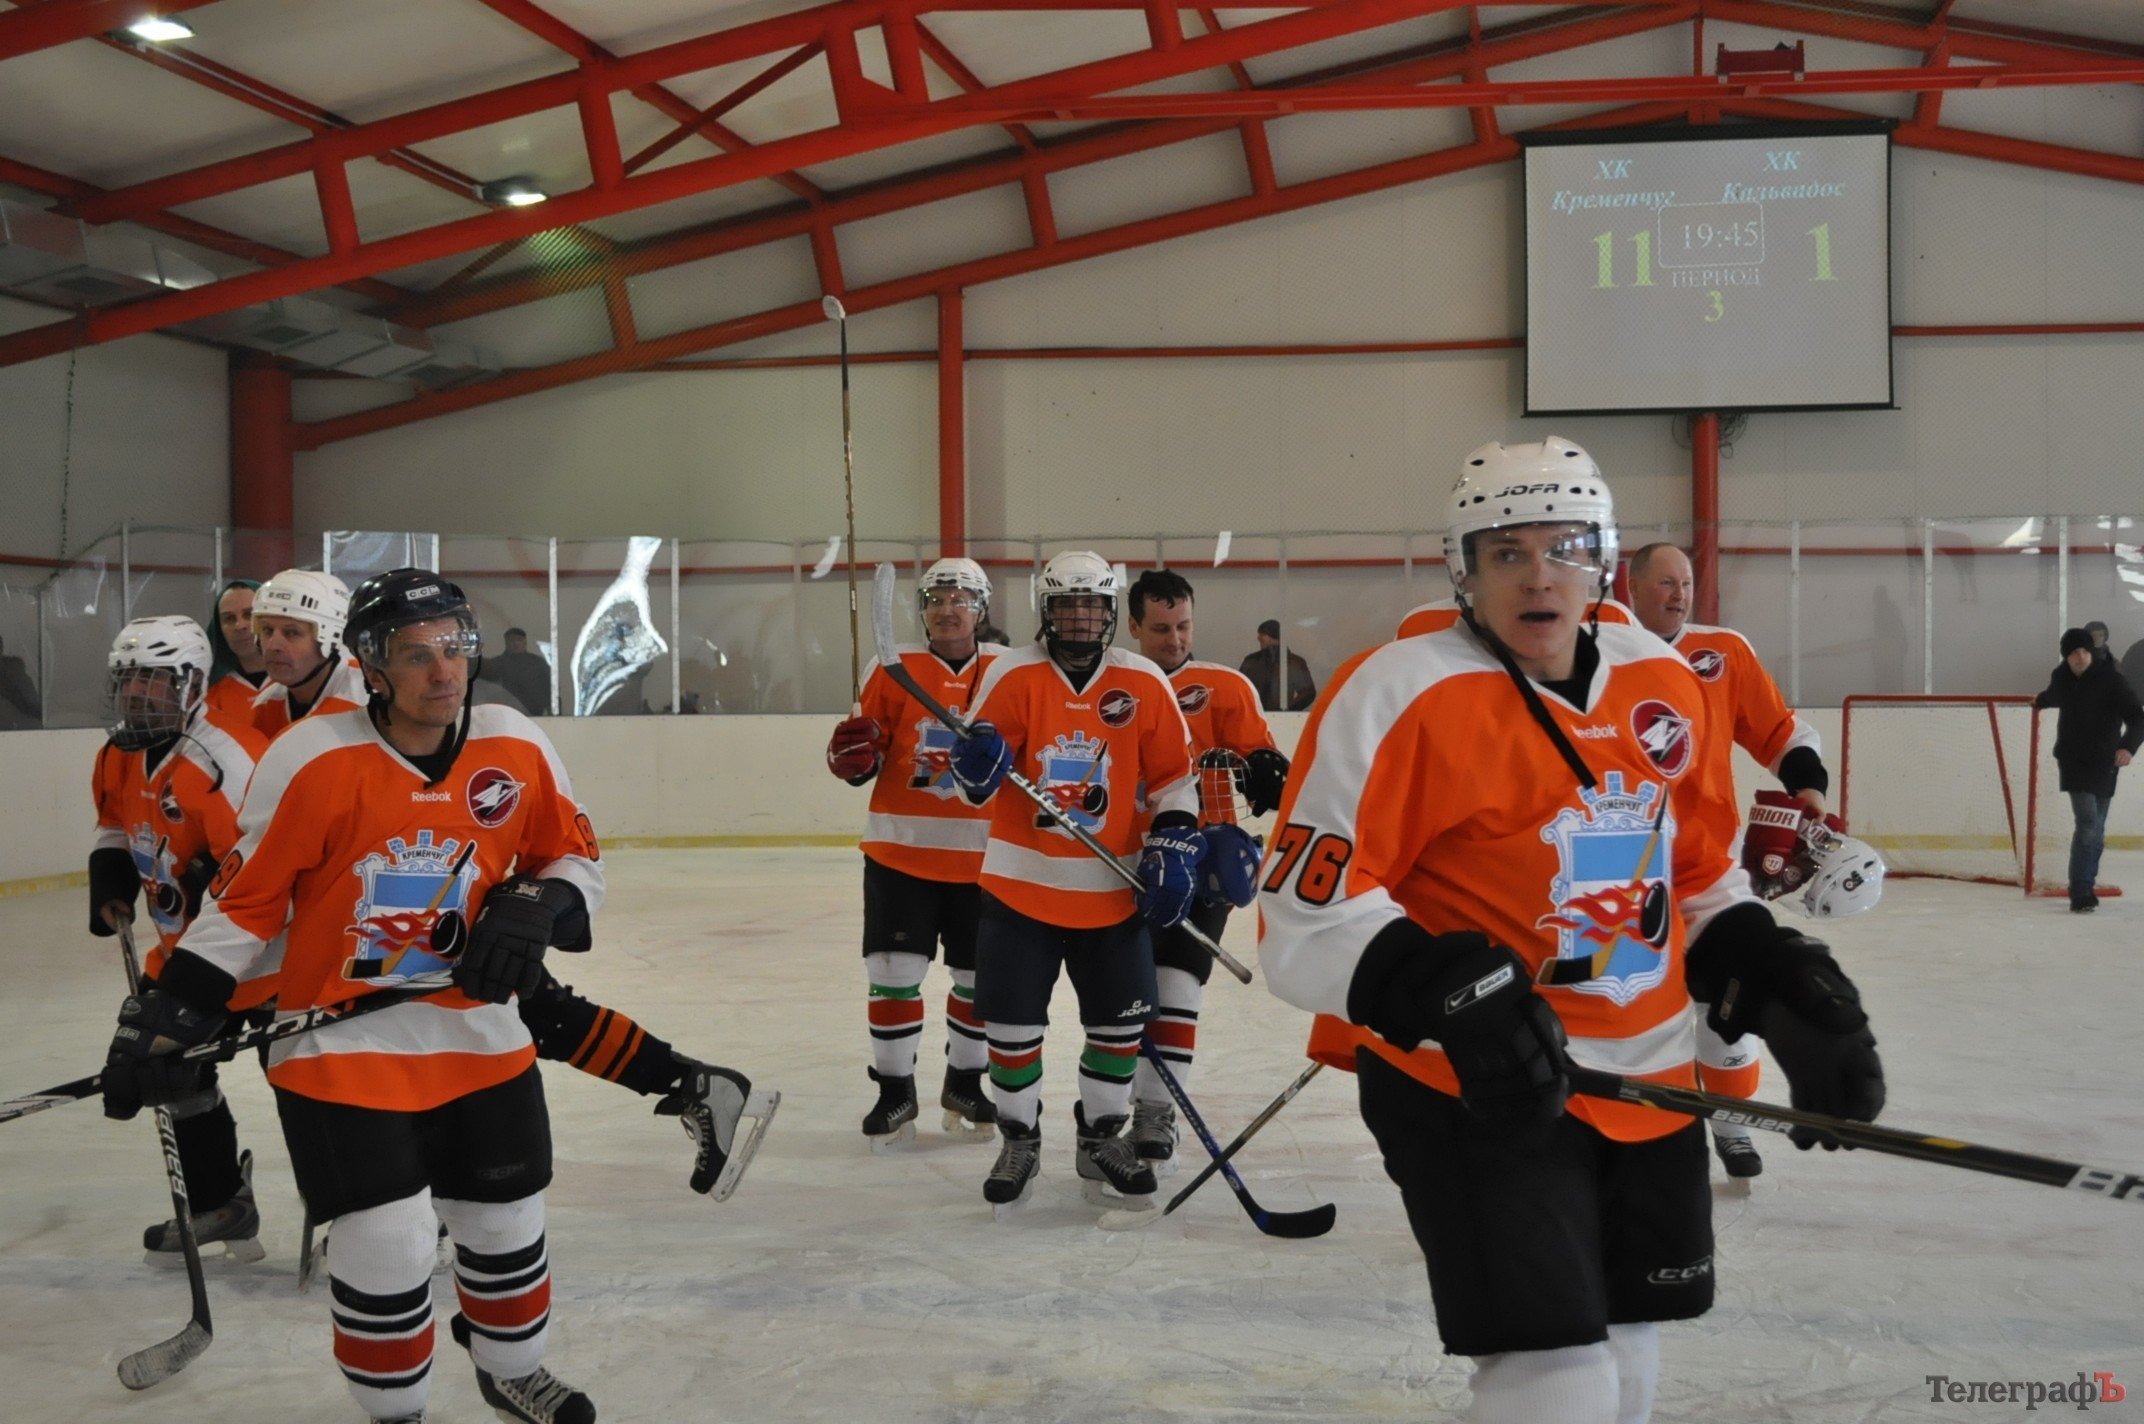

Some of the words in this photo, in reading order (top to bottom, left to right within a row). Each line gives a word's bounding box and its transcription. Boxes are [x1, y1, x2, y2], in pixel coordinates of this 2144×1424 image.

[1552, 190, 1676, 215] Кременчуг
[1683, 221, 1759, 250] 19:45
[1592, 230, 1657, 289] 11
[1805, 222, 1840, 283] 1
[1704, 290, 1725, 323] 3
[1494, 483, 1560, 499] JOFA
[407, 585, 440, 600] CCM
[1065, 701, 1091, 711] Reebok
[411, 791, 452, 802] Reebok
[1595, 798, 1643, 813] КРЕМЕНЧУГ
[1749, 807, 1795, 826] RRIOR
[401, 849, 445, 861] КРЕМЕНЧУГ
[1261, 822, 1353, 907] 76
[1117, 1004, 1152, 1018] JOFA
[1710, 1109, 1795, 1134] BAUER
[1657, 1261, 1710, 1279] CCM
